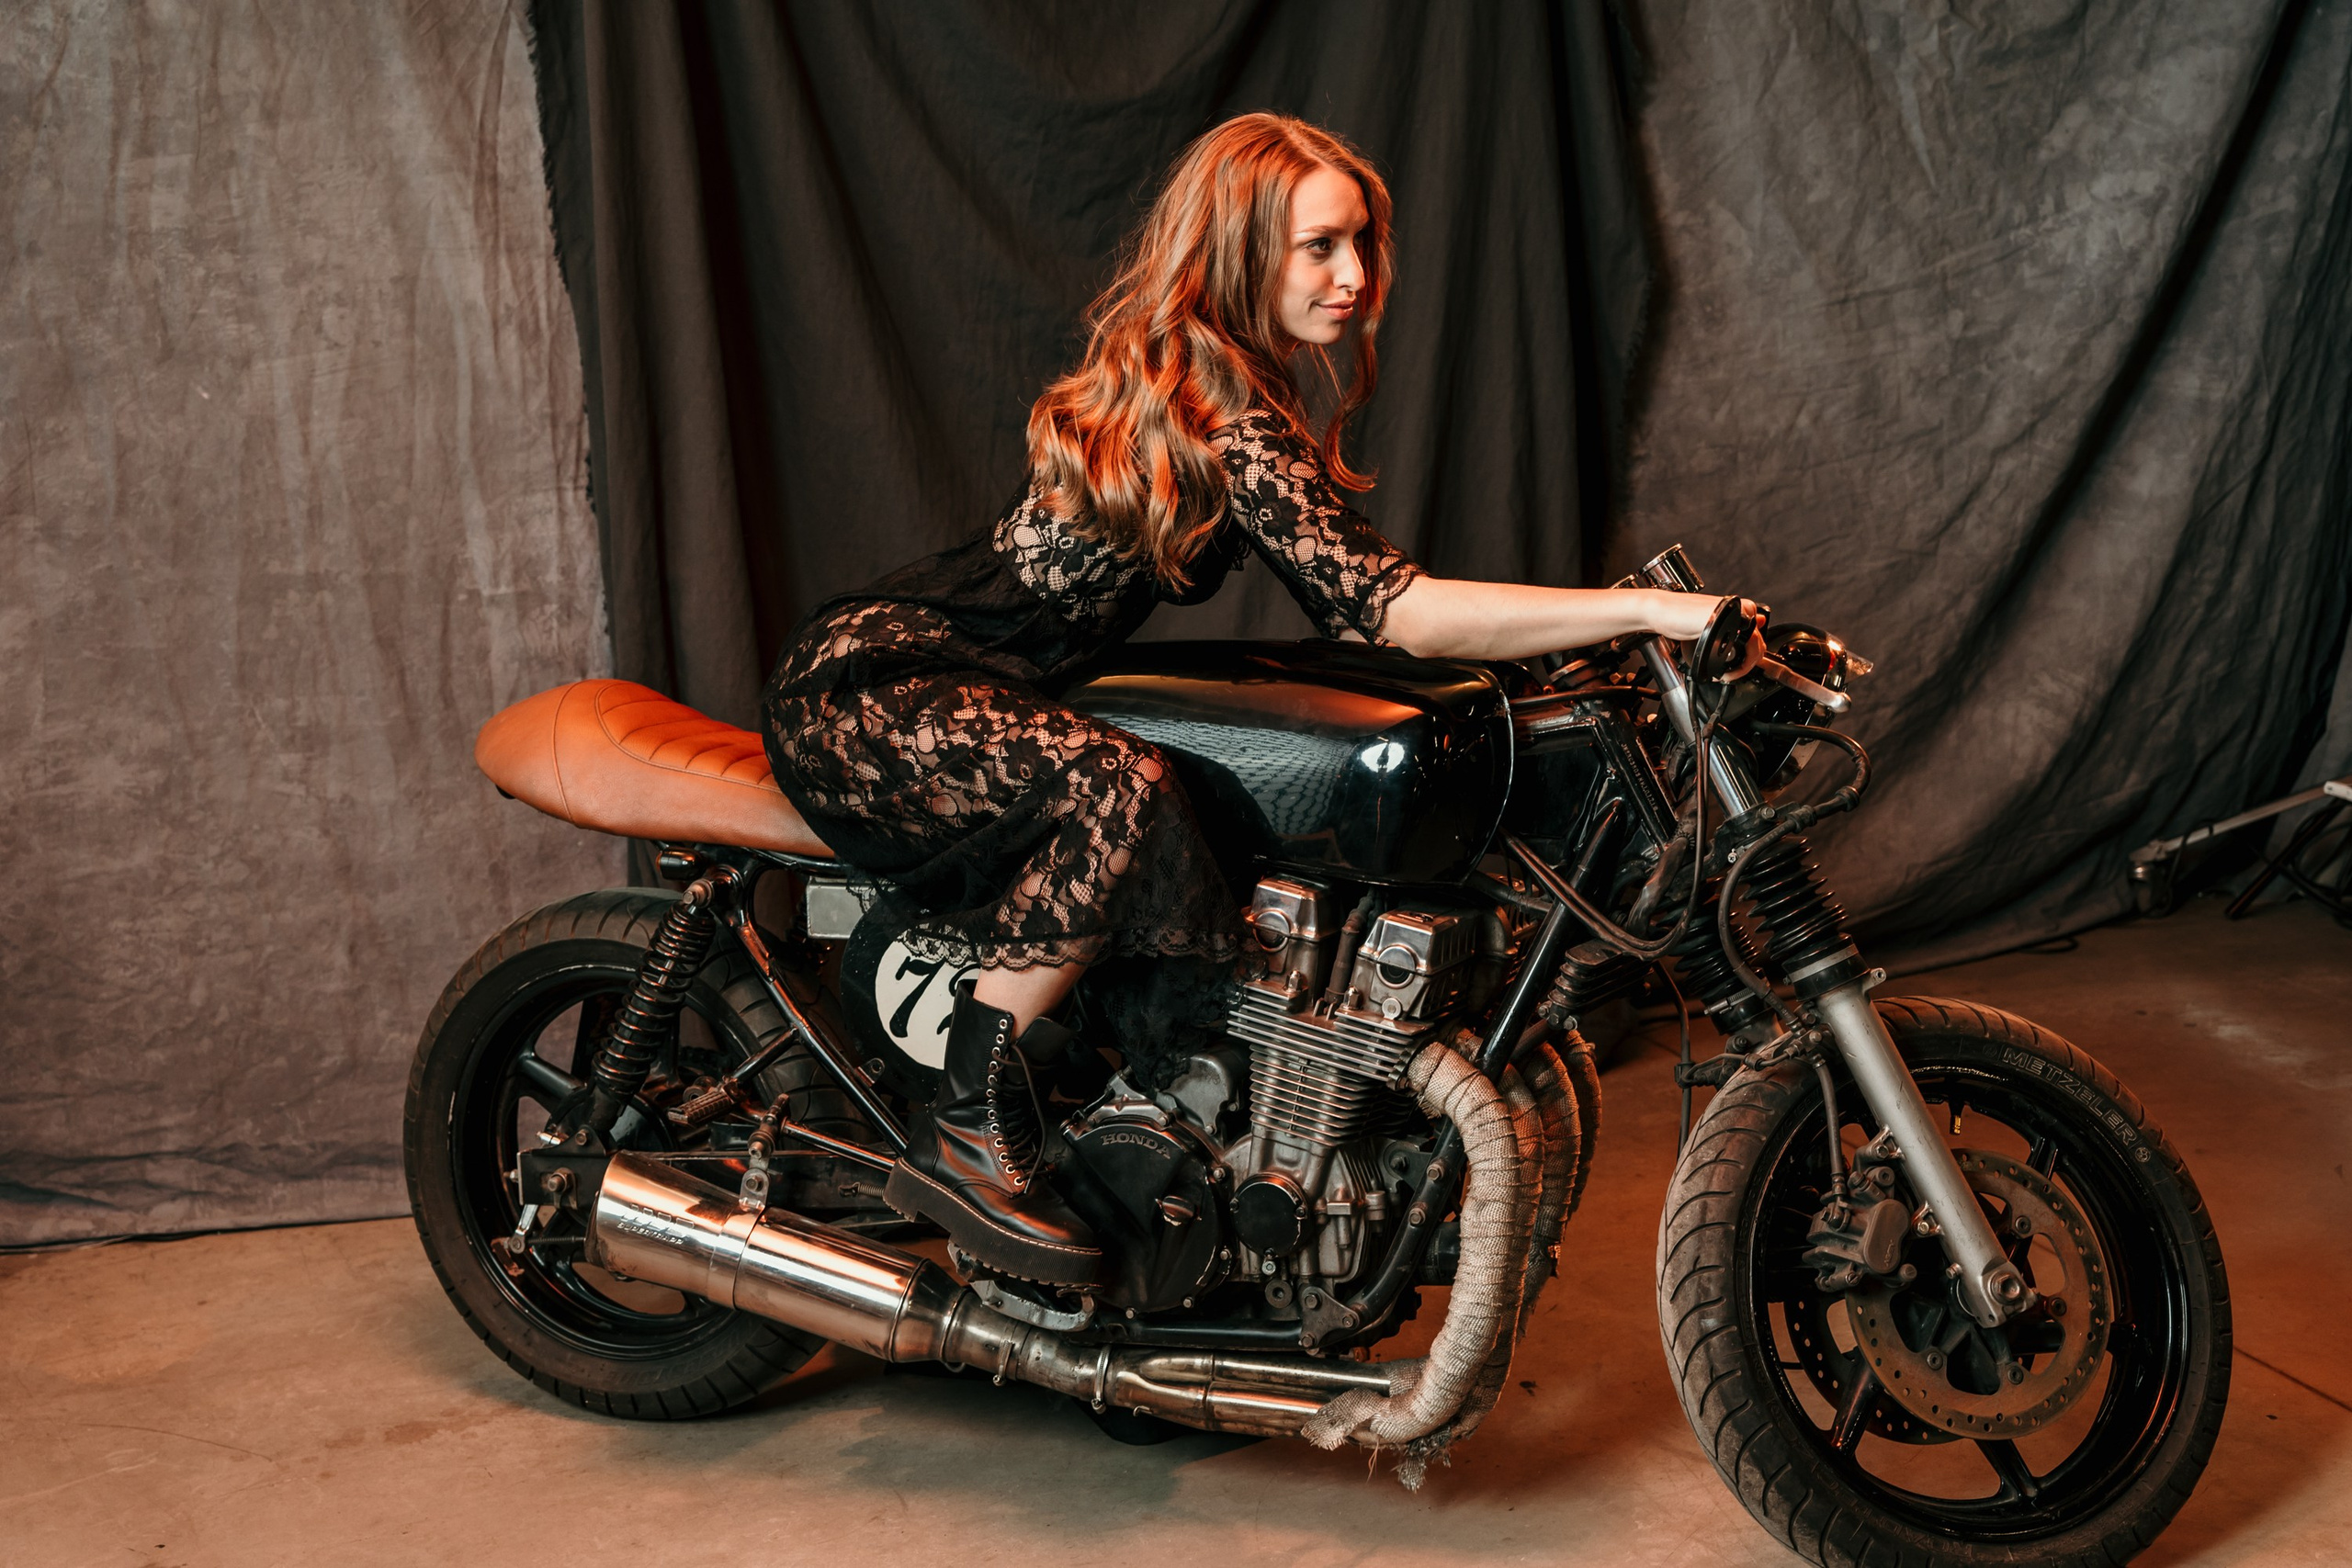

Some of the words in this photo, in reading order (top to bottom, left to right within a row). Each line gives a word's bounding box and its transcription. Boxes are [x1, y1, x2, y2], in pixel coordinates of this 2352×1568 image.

[2002, 1047, 2137, 1146] METZELER
[1101, 1133, 1171, 1159] HONDA
[616, 1222, 684, 1245] SUPERTRAPP
